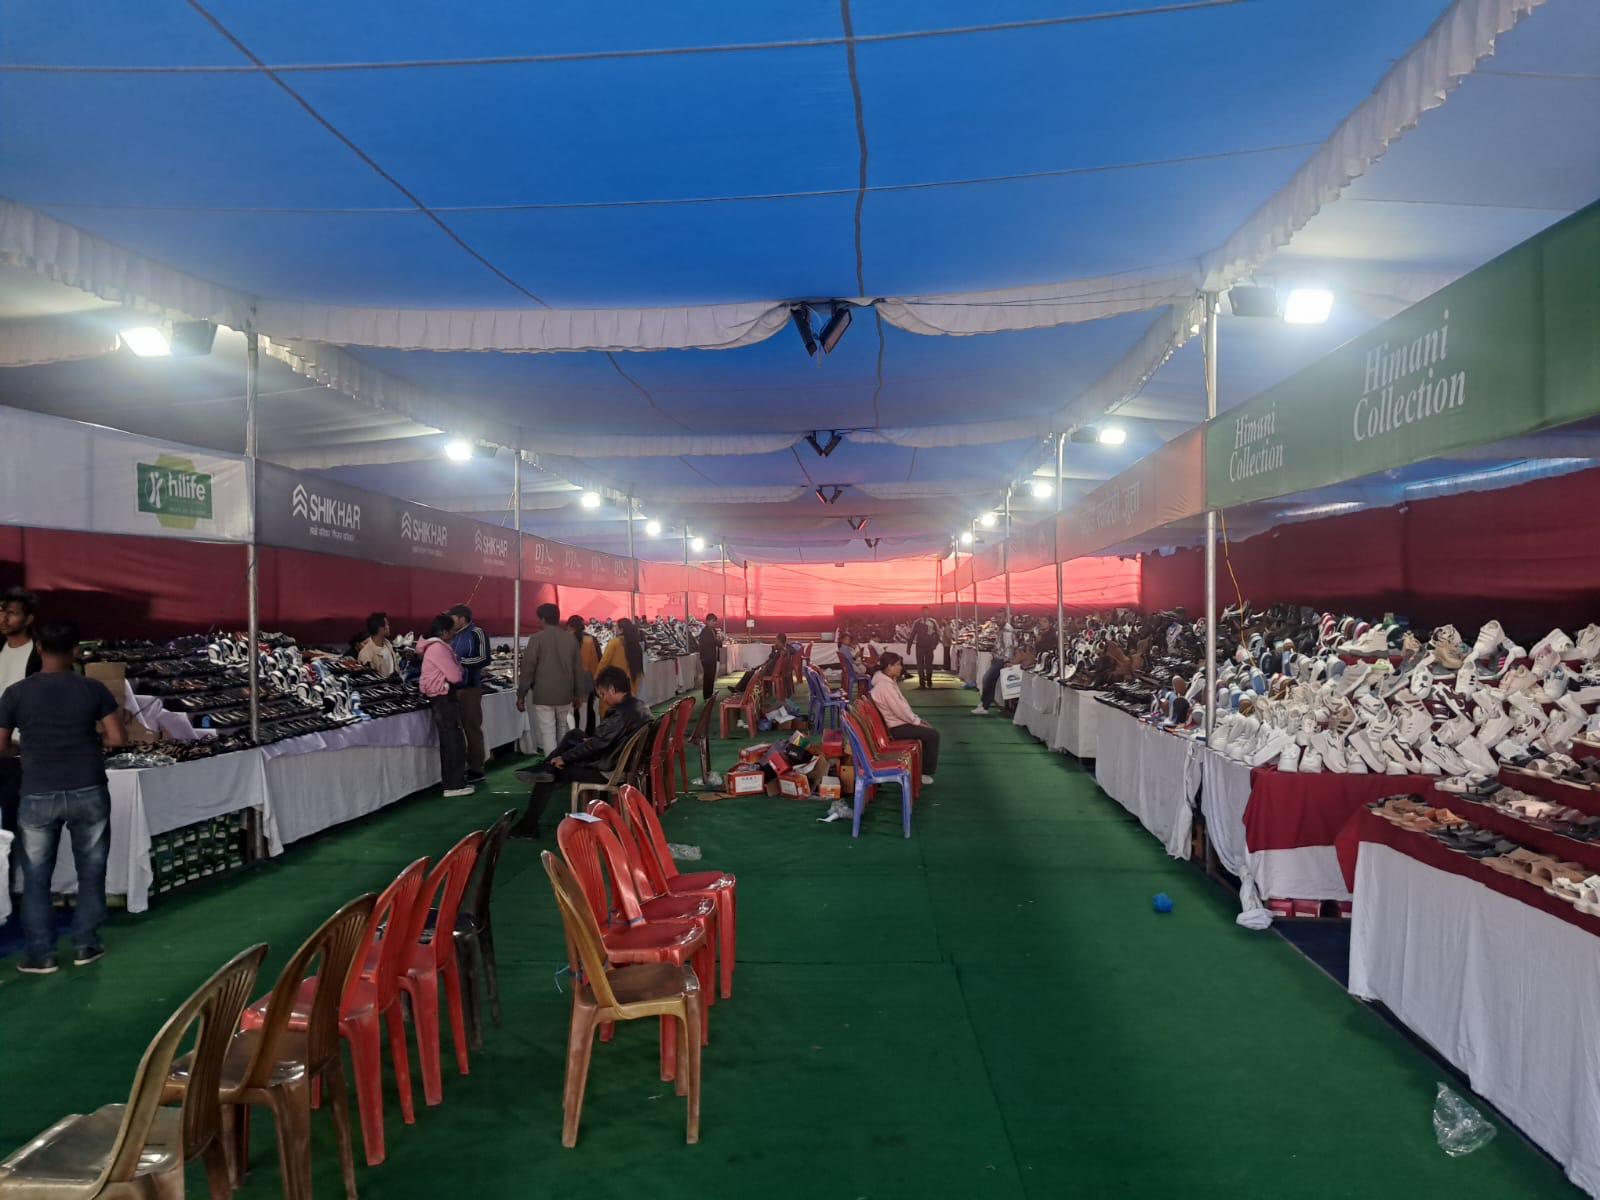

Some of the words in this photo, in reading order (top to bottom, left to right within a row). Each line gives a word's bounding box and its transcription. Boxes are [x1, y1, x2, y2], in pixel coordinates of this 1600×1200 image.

[1363, 309, 1449, 395] Himani
[1353, 368, 1466, 441] Collection
[1234, 400, 1276, 450] Himani
[1229, 439, 1284, 483] Collection
[168, 471, 206, 500] hilife
[310, 494, 361, 531] SHIKHAR
[412, 519, 448, 547] SHIKHAR
[482, 535, 508, 560] SHIKHAR
